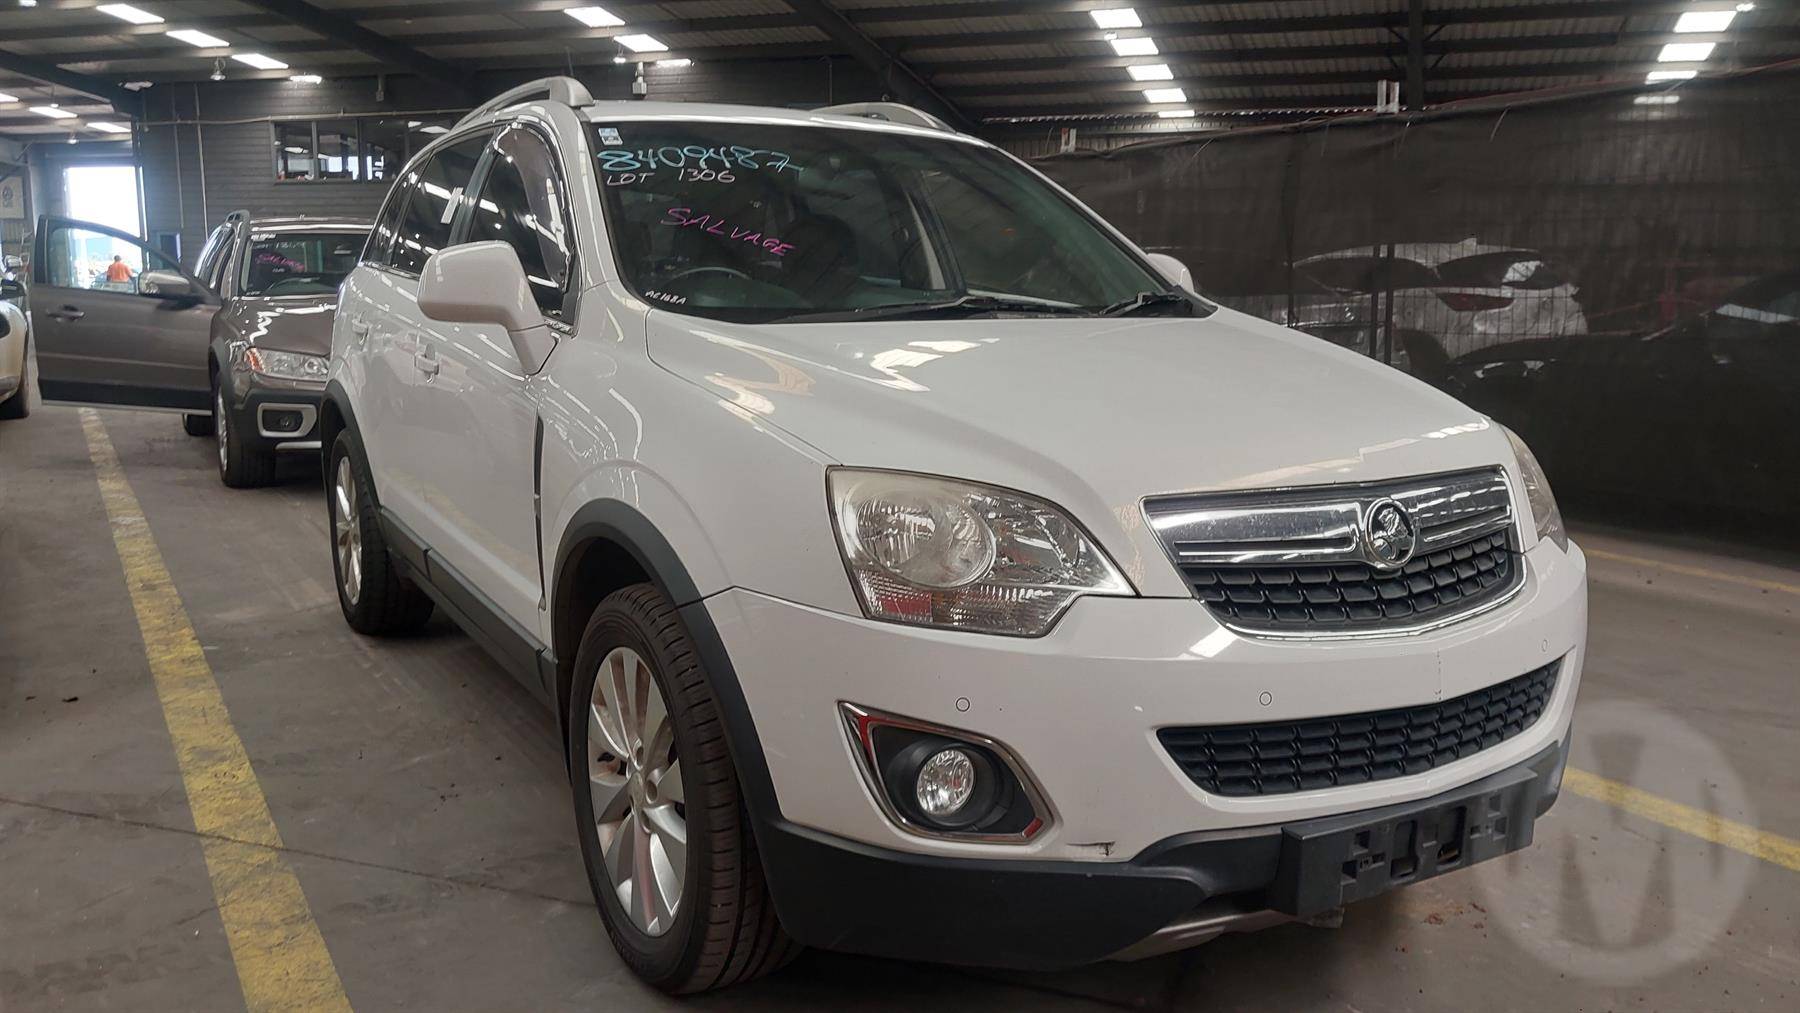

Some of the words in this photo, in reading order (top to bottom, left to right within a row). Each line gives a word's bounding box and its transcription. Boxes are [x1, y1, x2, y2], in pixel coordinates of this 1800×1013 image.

[597, 145, 804, 173] 8409487
[606, 172, 655, 186] LOT
[678, 168, 735, 184] 1306
[660, 207, 799, 257] SALVAGE
